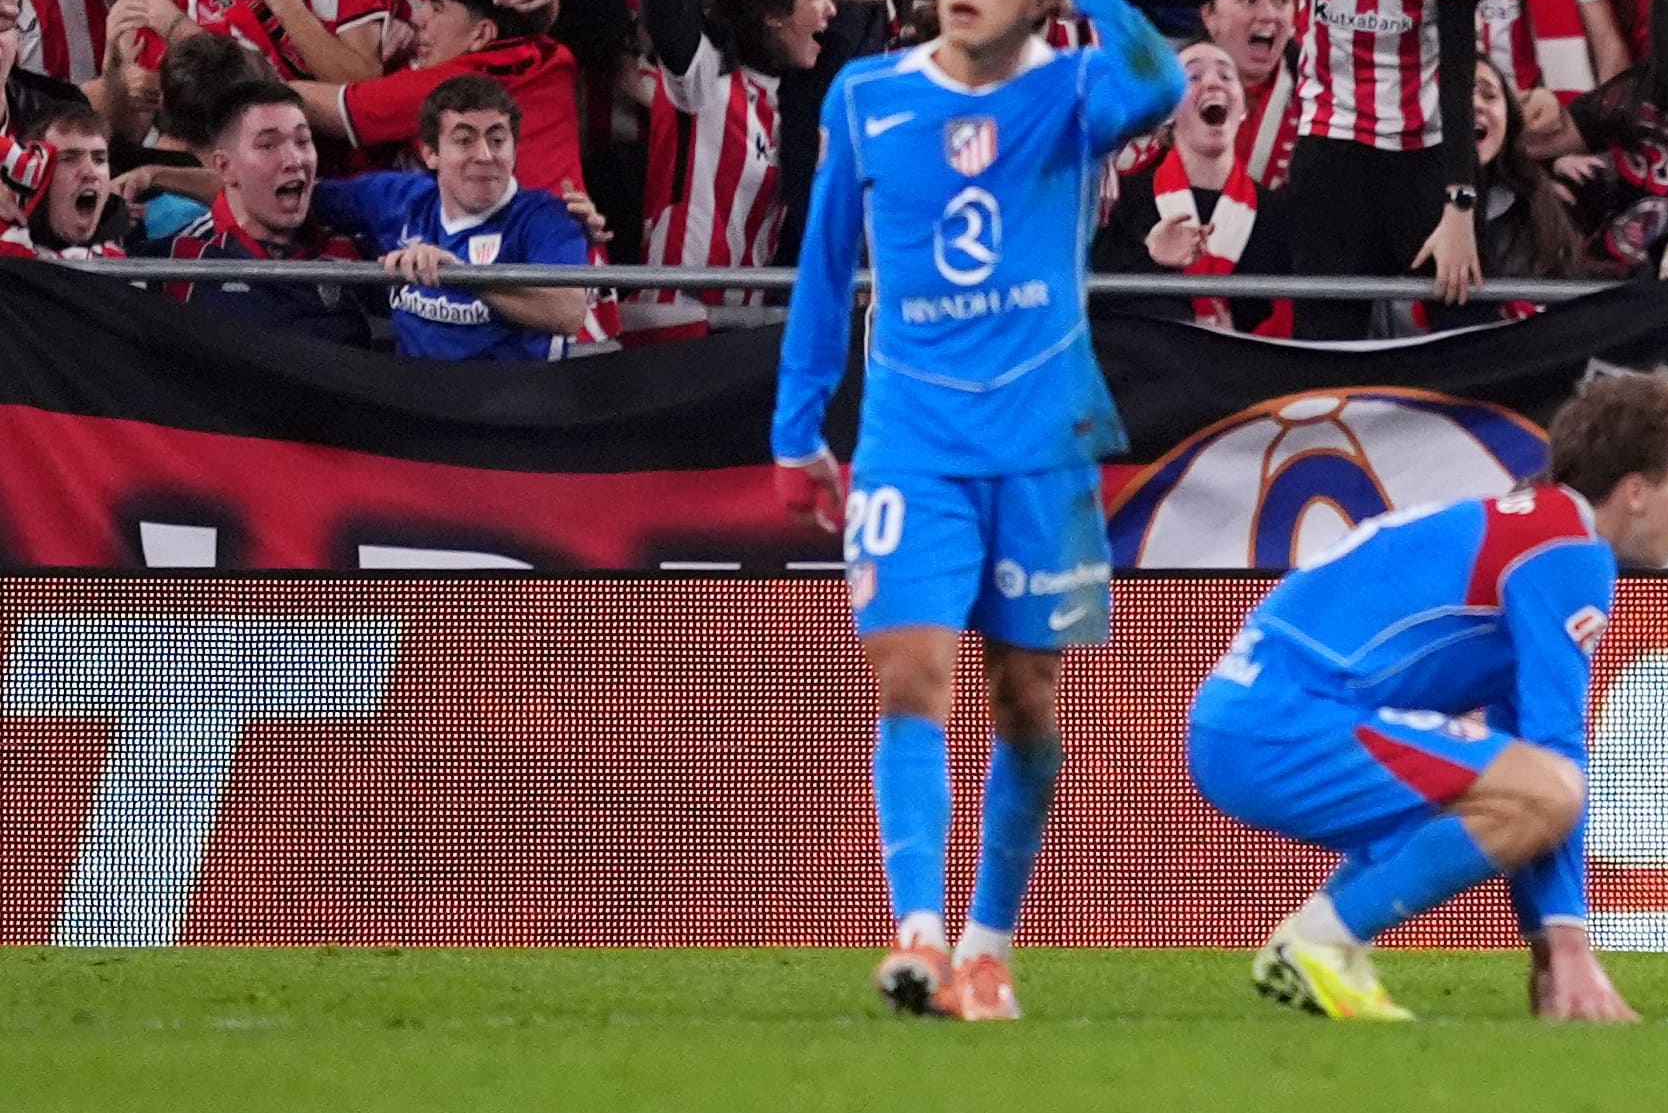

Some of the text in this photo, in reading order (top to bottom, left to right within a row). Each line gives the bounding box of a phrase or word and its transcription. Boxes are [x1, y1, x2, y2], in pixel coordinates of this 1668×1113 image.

[901, 279, 1049, 323] RIYADH AIR
[844, 486, 905, 562] 20
